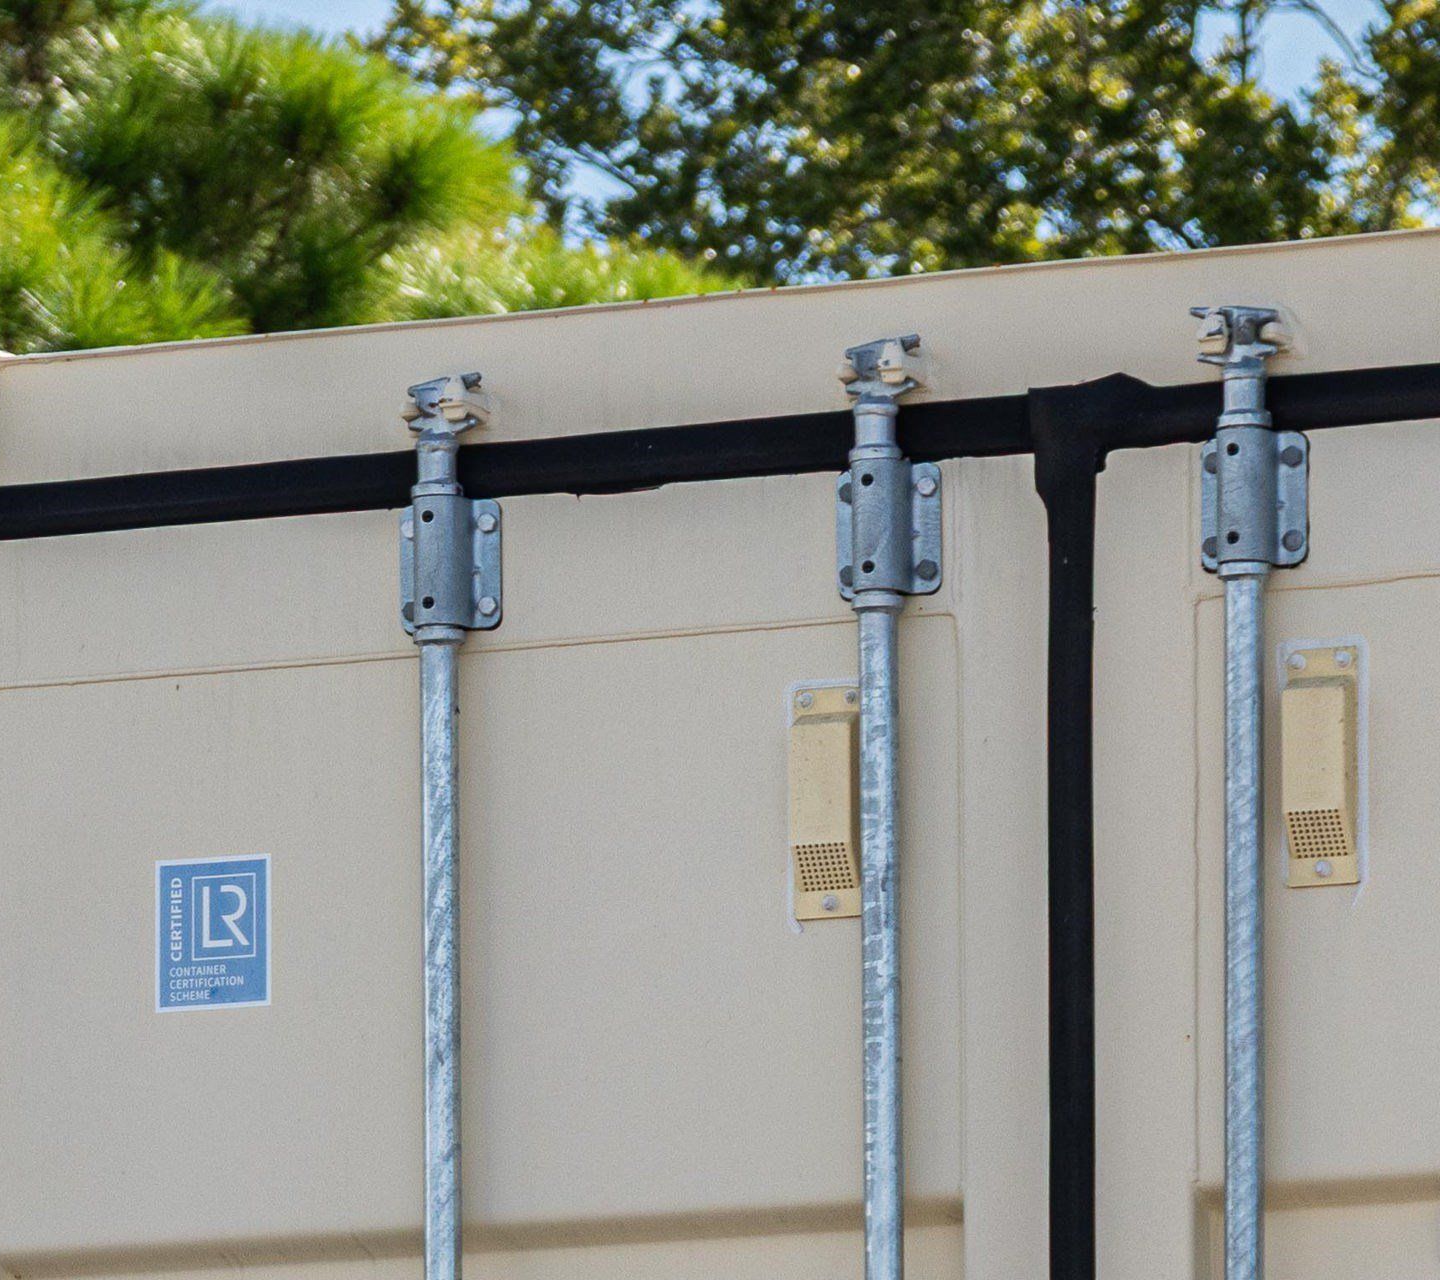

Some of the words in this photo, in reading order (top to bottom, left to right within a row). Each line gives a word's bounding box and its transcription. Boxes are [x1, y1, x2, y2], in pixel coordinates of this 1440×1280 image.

[170, 877, 183, 962] CERTIFIED
[202, 884, 250, 948] LR
[169, 964, 227, 978] CONTAINER
[169, 975, 245, 990] CERTIFICATION
[169, 989, 211, 1002] SCHEME
